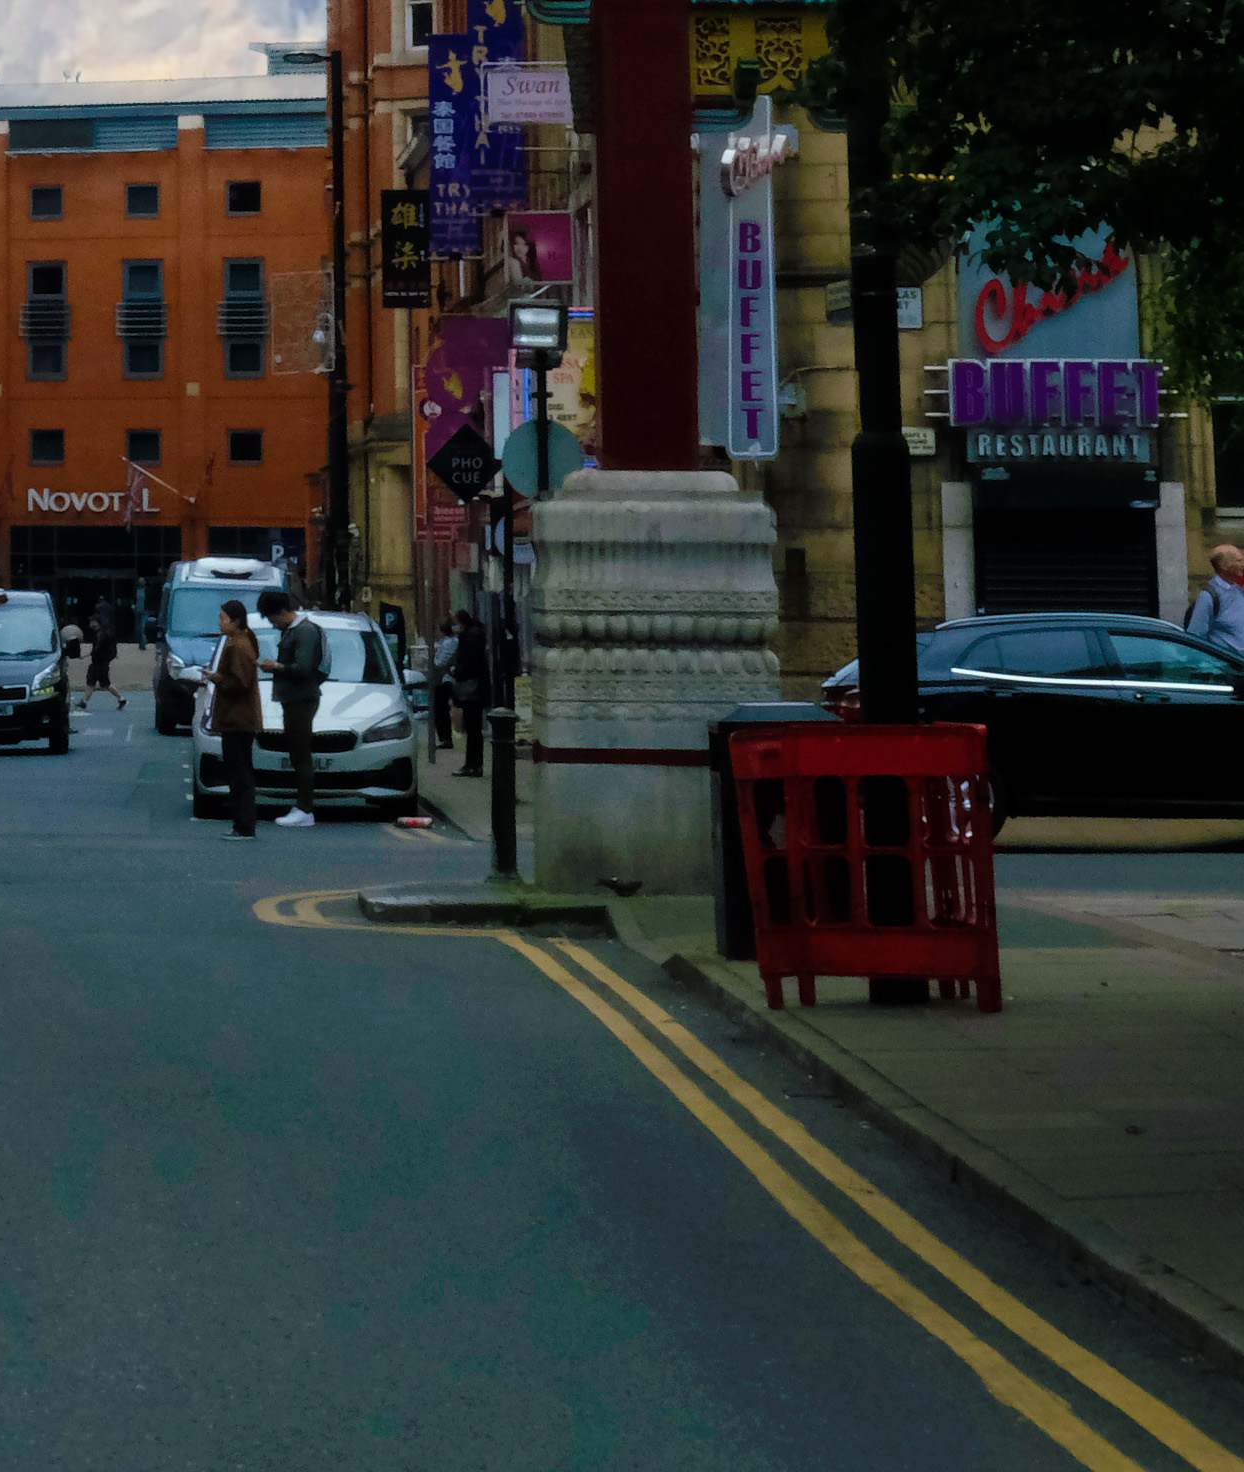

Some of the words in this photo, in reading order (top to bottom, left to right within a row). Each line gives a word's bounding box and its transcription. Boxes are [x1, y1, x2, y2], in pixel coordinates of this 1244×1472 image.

[501, 75, 561, 96] Swan
[737, 221, 762, 440] BUFFET
[950, 359, 1164, 427] BUFFET
[977, 433, 1141, 457] RESTAURANT
[451, 456, 484, 469] PHO
[451, 471, 481, 484] CUE
[27, 487, 161, 513] NOVOTL
